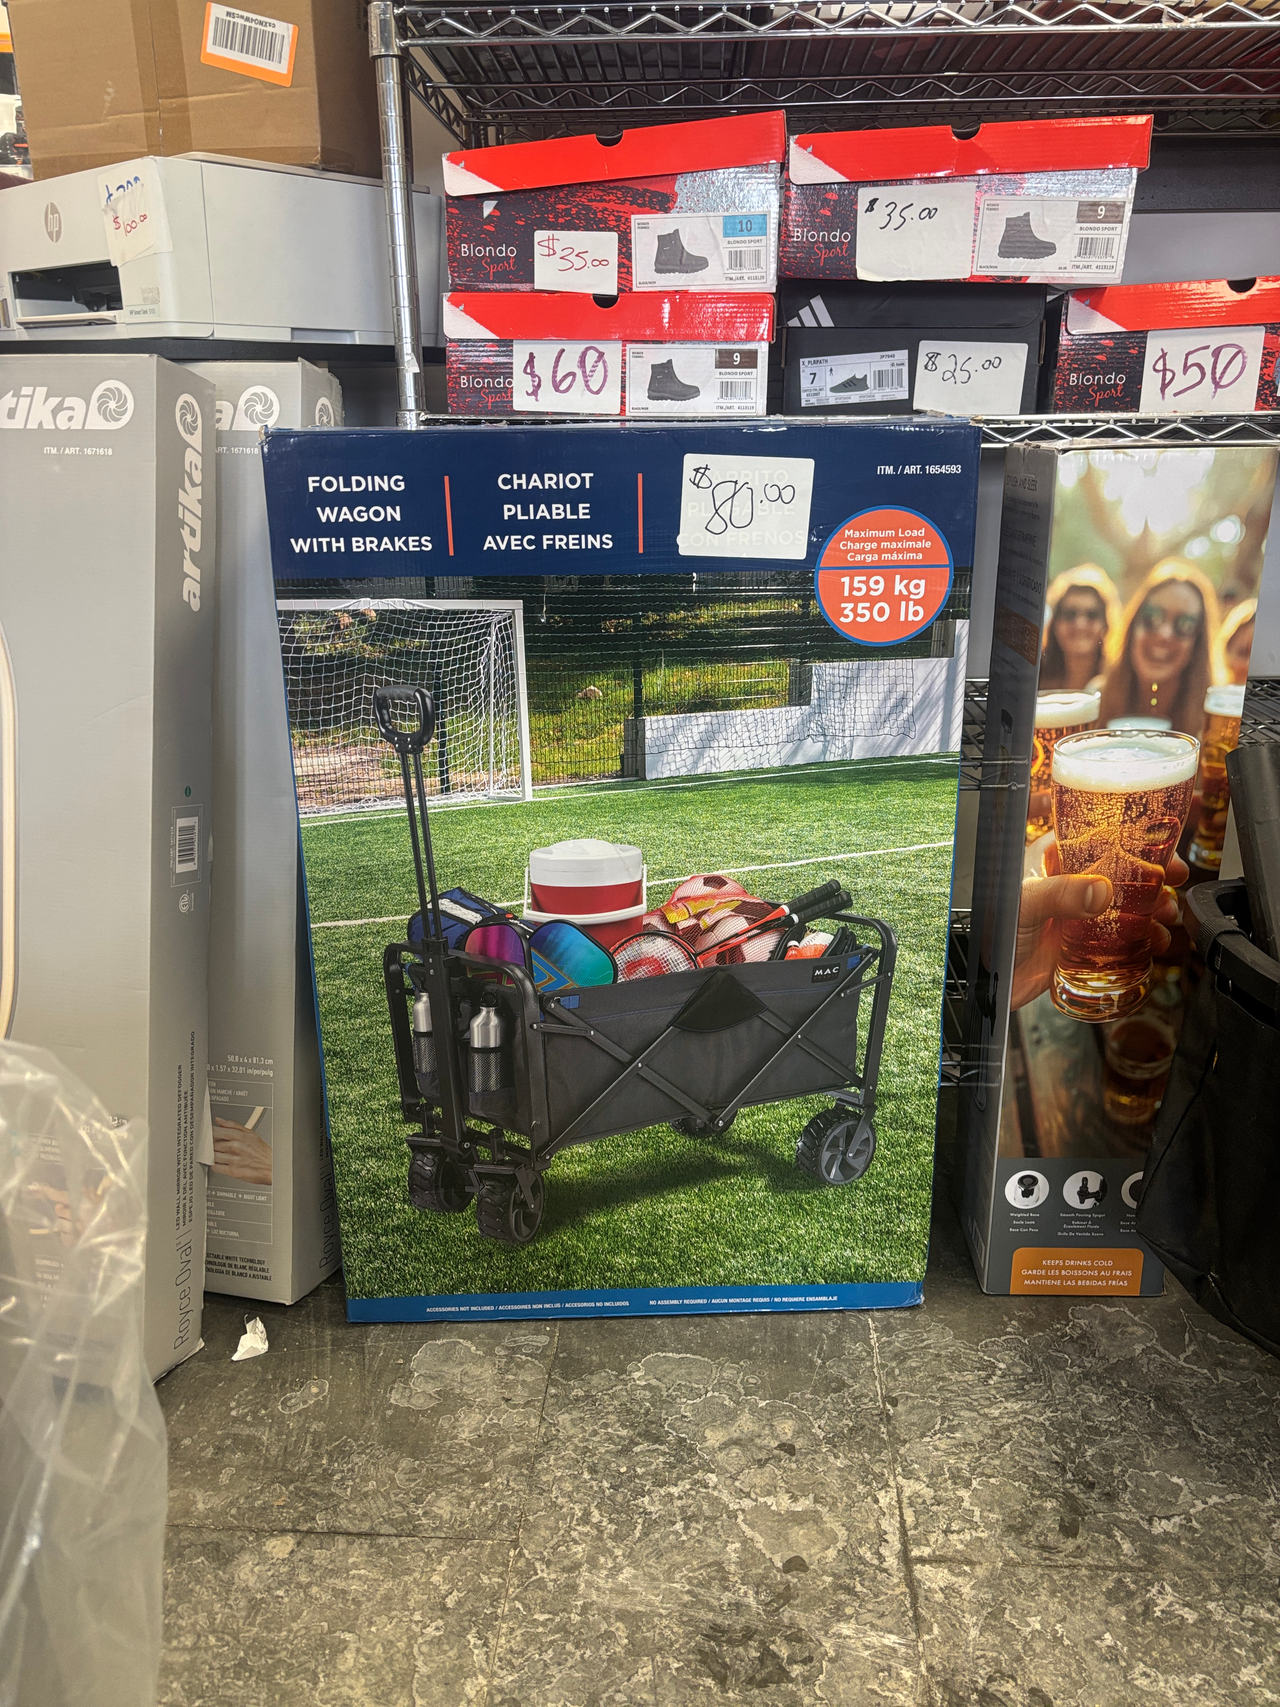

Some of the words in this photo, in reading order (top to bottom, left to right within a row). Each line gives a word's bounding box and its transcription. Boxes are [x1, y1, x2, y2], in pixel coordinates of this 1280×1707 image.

[864, 197, 938, 231] $35.00
[1097, 205, 1106, 219] 9
[738, 219, 753, 233] 10
[792, 228, 851, 242] Blondo
[461, 243, 517, 257] Blondo
[537, 233, 610, 272] $35.00
[812, 242, 849, 267] Sport
[480, 258, 518, 280] Sport
[733, 352, 741, 365] 9
[522, 345, 609, 402] $60
[923, 351, 1002, 385] $25.00
[1152, 343, 1248, 401] $50
[460, 375, 513, 388] Blondo
[809, 372, 817, 385] 7
[1069, 371, 1127, 386] Blondo
[1088, 385, 1124, 403] Sport
[43, 446, 60, 455] ITM.
[64, 447, 82, 455] ART.
[877, 465, 896, 475] ITM.
[897, 465, 902, 475] /
[903, 465, 923, 475] ART.
[925, 464, 962, 475] 1654593
[307, 475, 406, 493] FOLDING
[497, 472, 594, 491] CHARIOT
[316, 505, 401, 523] WAGON
[503, 503, 591, 520] PLIABLE
[178, 447, 202, 612] artika
[844, 529, 896, 538] Maximum
[898, 528, 925, 537] Load
[290, 537, 346, 554] WITH
[351, 535, 433, 552] BRAKES
[483, 535, 536, 551] AVEC
[542, 534, 613, 550] FREINS
[840, 541, 878, 551] Charge
[880, 539, 932, 549] maximale
[847, 552, 878, 562] Carga
[881, 551, 923, 561] máxima
[840, 575, 885, 597] 159
[894, 574, 926, 600] kg
[839, 602, 891, 623] 350
[900, 601, 924, 622] lb
[814, 966, 840, 976] MAC
[175, 1239, 192, 1287] Oval
[1108, 1279, 1128, 1287] FRÍAS
[174, 1286, 194, 1350] Royce
